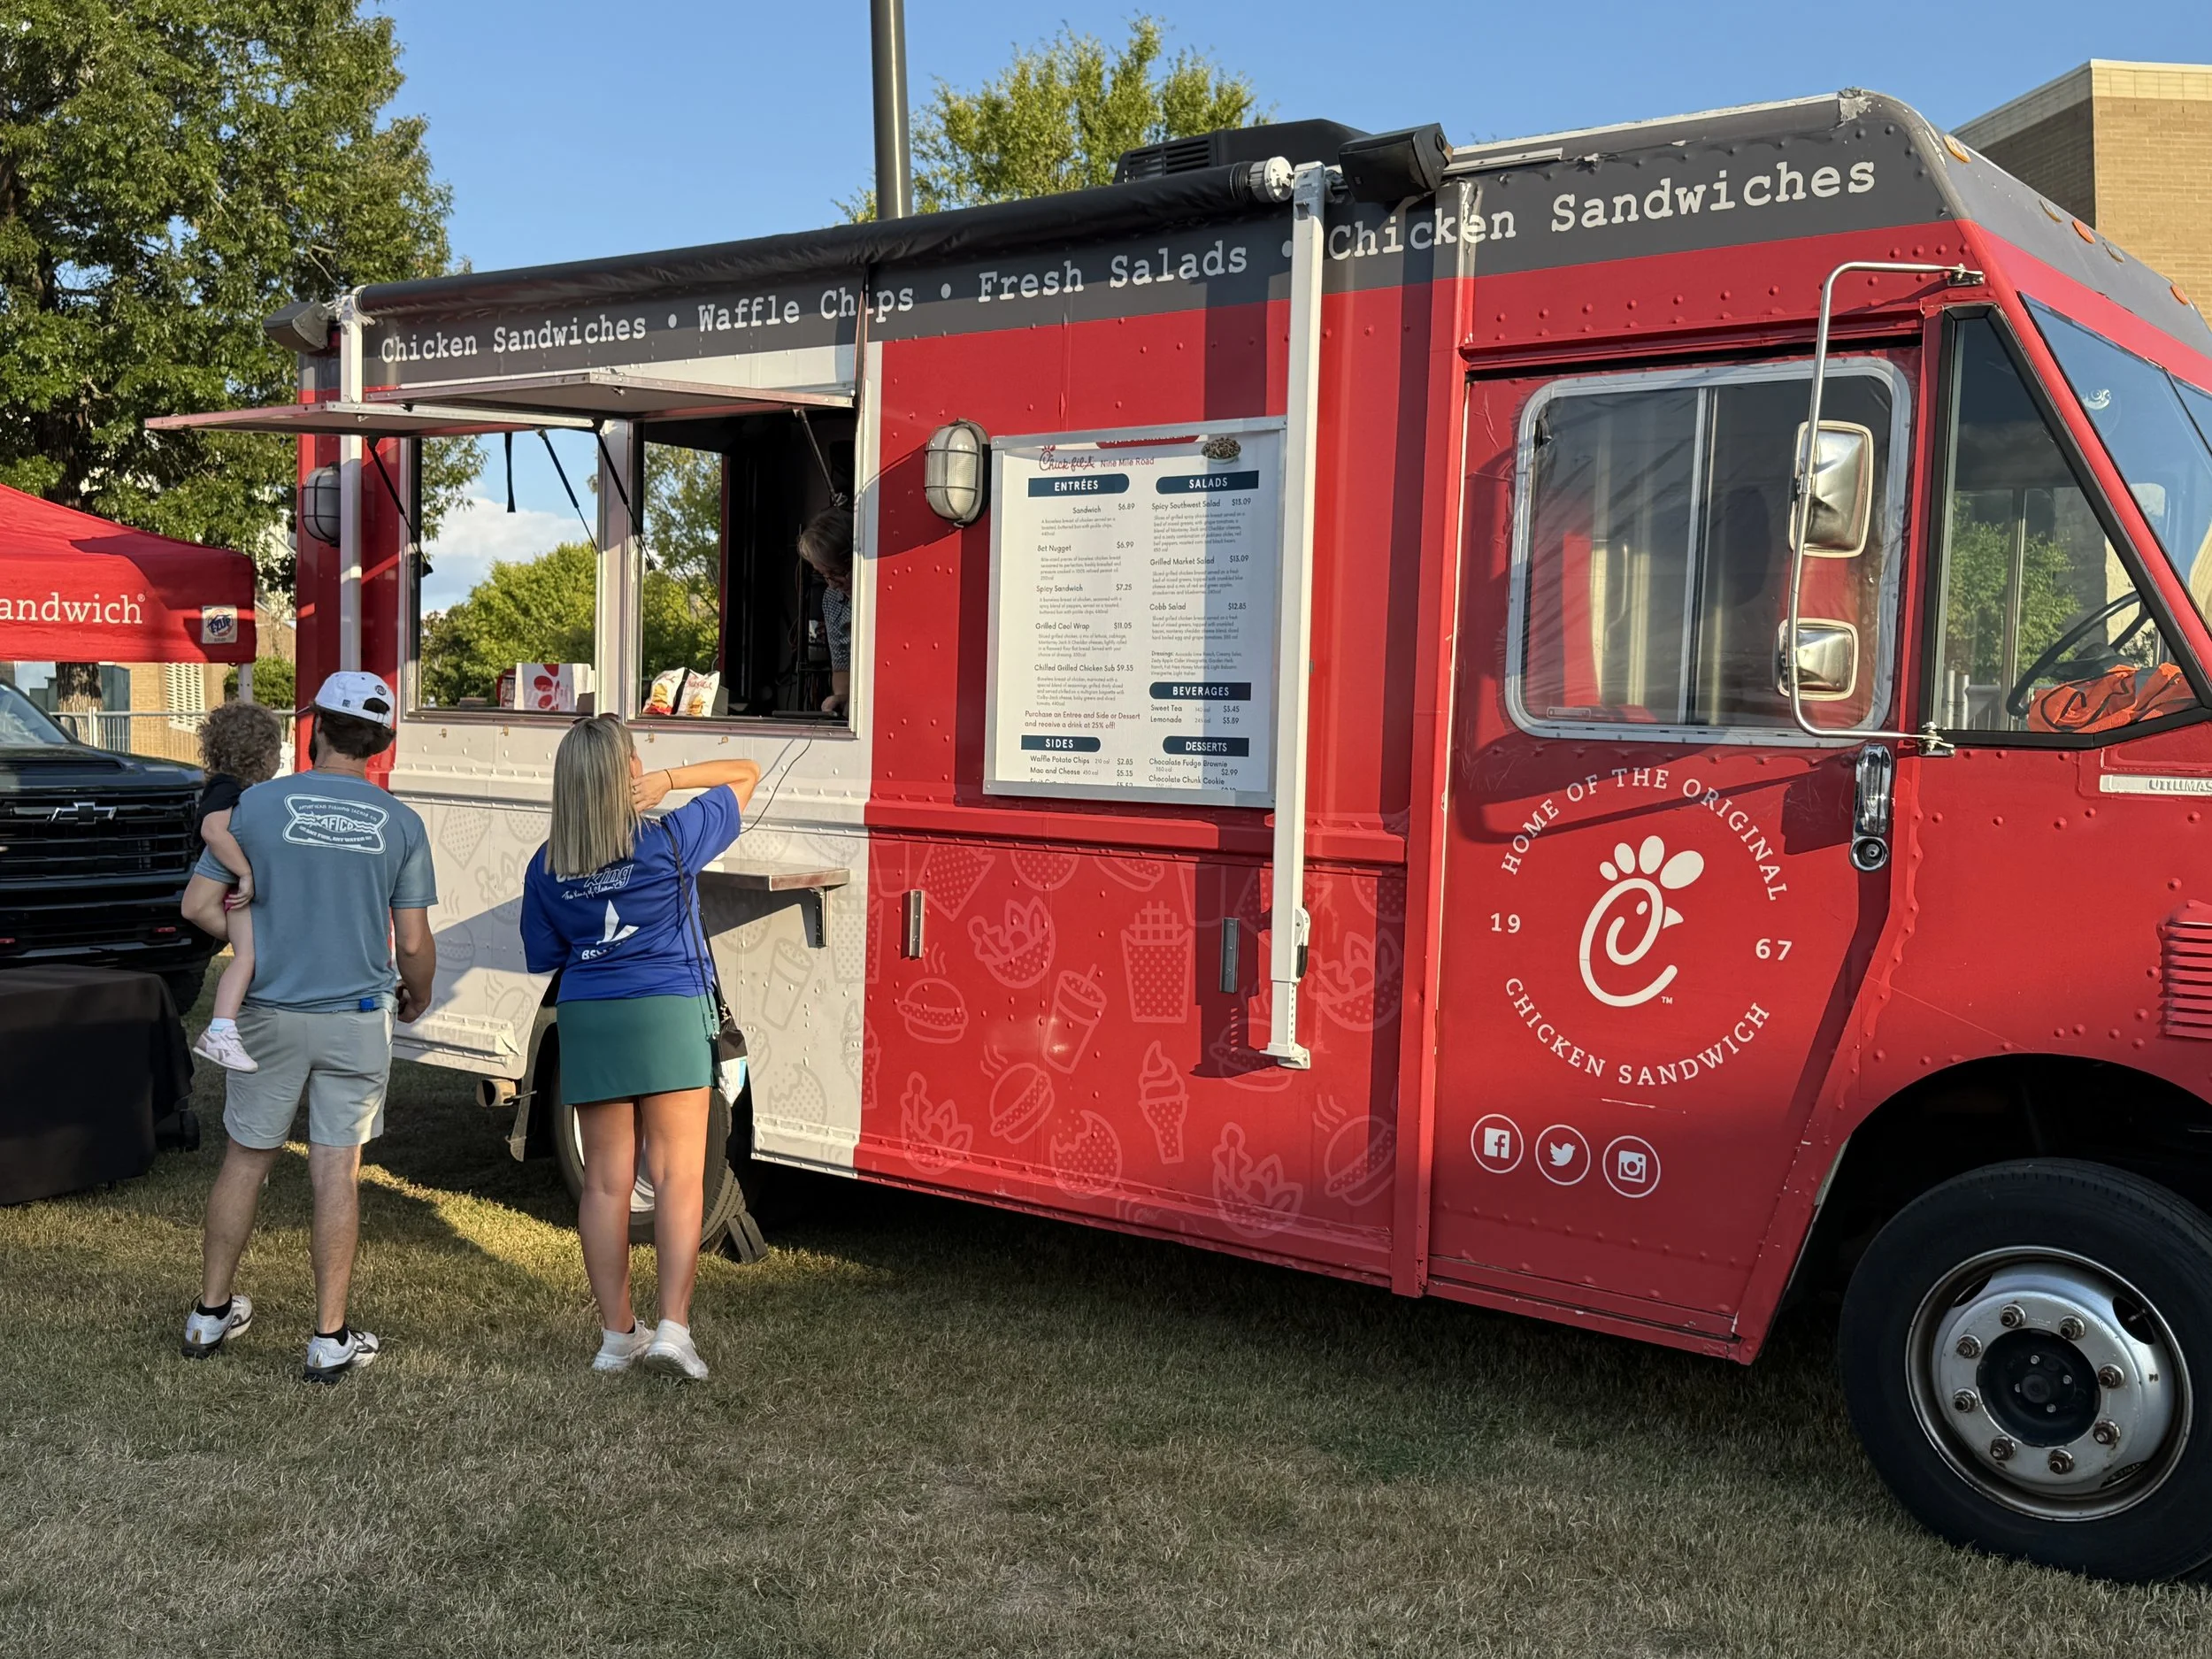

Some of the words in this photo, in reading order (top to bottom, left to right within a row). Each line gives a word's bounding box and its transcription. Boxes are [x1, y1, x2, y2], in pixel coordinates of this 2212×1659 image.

[381, 333, 479, 365] Chicken
[493, 315, 647, 354] Sandwiches
[697, 294, 801, 334] Waffle
[978, 261, 1084, 303] Fresh
[1109, 241, 1247, 288] Salads
[1327, 207, 1517, 262] Chicken
[1550, 160, 1876, 233] Sandwiches
[1101, 459, 1117, 468] Nine
[1118, 457, 1133, 466] Mile
[1135, 457, 1154, 465] Road
[1054, 478, 1099, 492] ENTRÉES
[1188, 477, 1228, 489] SALADS
[1072, 505, 1102, 514] Sandwich
[1151, 502, 1168, 513] Spicy
[1170, 500, 1201, 510] Southwest
[1202, 498, 1221, 508] Salad
[1048, 544, 1071, 554] Nugget
[1116, 541, 1134, 549] $6.99
[1149, 557, 1171, 566] Grilled
[1172, 557, 1195, 565] Market
[1196, 556, 1215, 565] Salad
[1036, 585, 1053, 594] Spicy
[1073, 622, 1090, 632] Wrap
[1079, 664, 1103, 672] Chicken
[1172, 686, 1229, 696] BEVERAGES
[1025, 710, 1053, 718] Purchase
[1118, 711, 1141, 720] Dessert
[1105, 721, 1116, 730] off!
[1045, 738, 1074, 749] SIDES
[1185, 741, 1227, 752] DESSERTS
[1072, 757, 1090, 765] Chips
[1148, 757, 1181, 766] Chocolate
[1182, 758, 1202, 769] Fudge
[1202, 759, 1228, 768] Brownie
[1221, 767, 1239, 776] $2.99
[1148, 774, 1181, 783] Chocolate
[1182, 775, 1202, 784] Chunk
[1202, 776, 1225, 786] Cookie
[1501, 799, 1560, 875] HOME
[1566, 774, 1599, 803] OF
[1612, 767, 1670, 789] THE
[1682, 778, 1788, 902] ORIGINAL
[1490, 912, 1521, 933] 19
[1755, 938, 1793, 962] 67
[1505, 978, 1606, 1078] CHICKEN
[1617, 1002, 1770, 1086] SANDWICH
